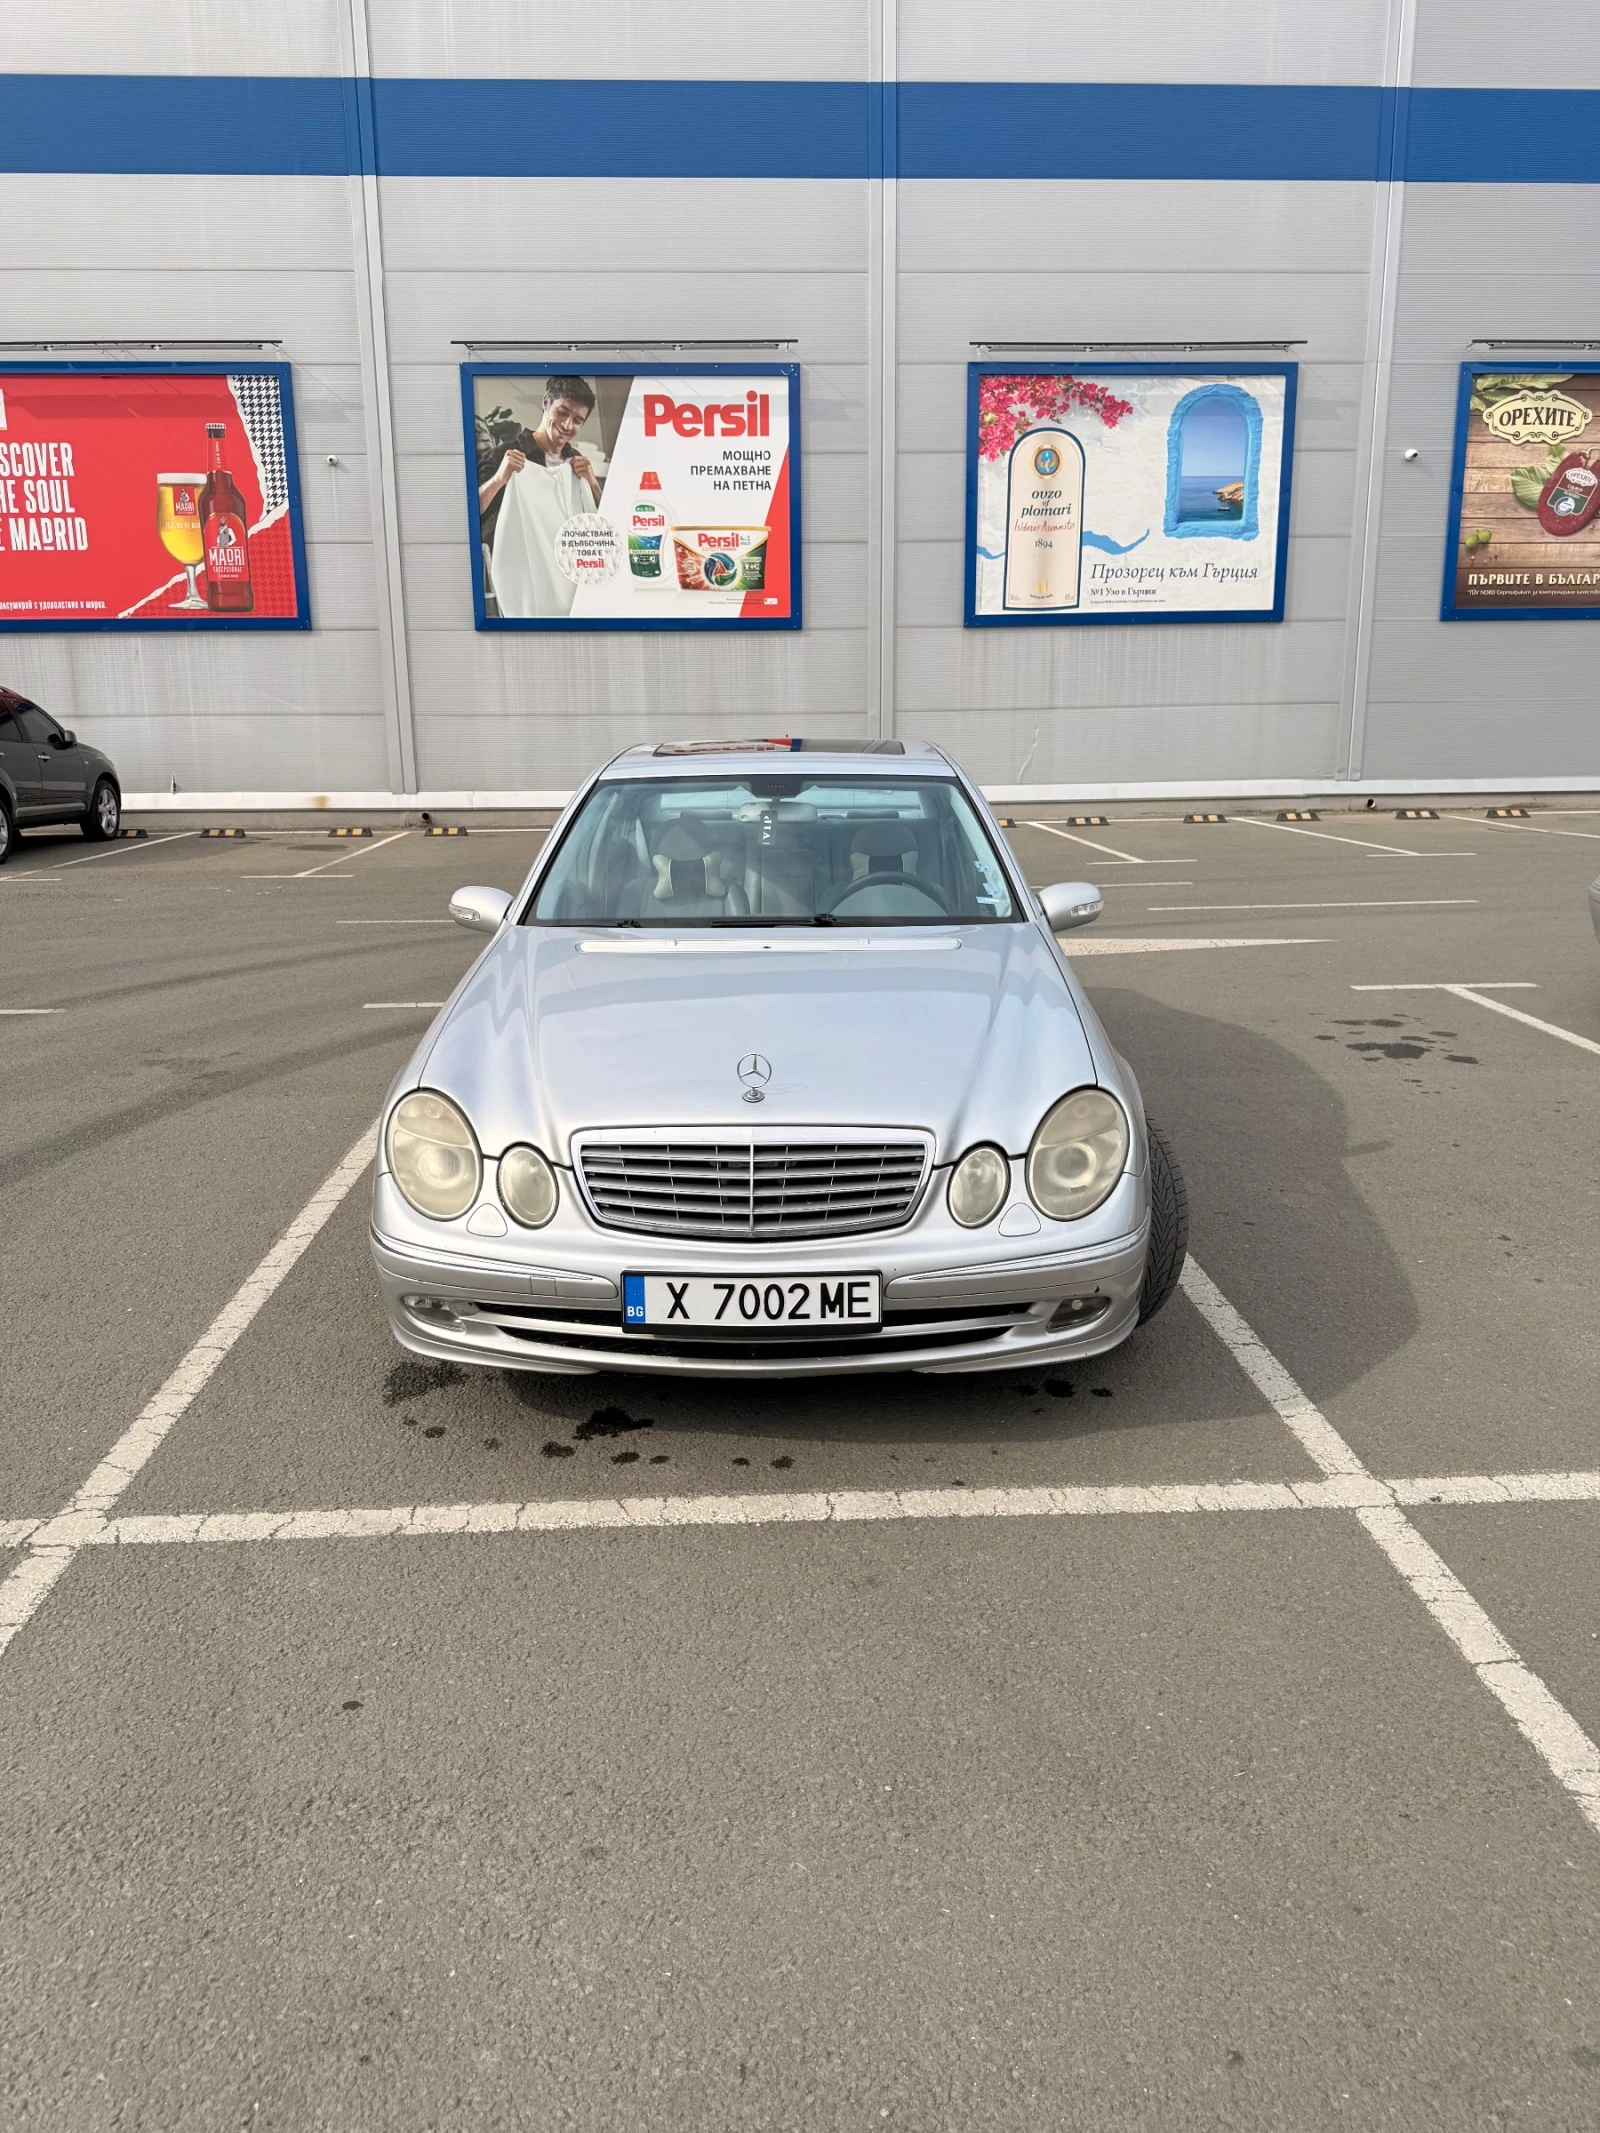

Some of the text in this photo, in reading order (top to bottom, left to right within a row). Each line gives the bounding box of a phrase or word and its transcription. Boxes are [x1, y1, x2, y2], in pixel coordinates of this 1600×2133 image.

[643, 390, 770, 438] Persil
[1499, 406, 1577, 427] ОРЕХИТЕ
[722, 450, 771, 462] МОЩНО
[690, 465, 771, 476] ПРЕМАХВАНЕ
[713, 480, 772, 491] НА ПЕТНА
[23, 479, 76, 514] SOUL
[1031, 490, 1062, 499] ouzo
[1021, 503, 1072, 518] plomari
[632, 514, 665, 527] Persil
[8, 517, 88, 551] MADRID
[564, 530, 614, 538] ПОЧИСТВАНЕ
[697, 532, 740, 548] Persil
[1035, 539, 1053, 549] 1894
[576, 558, 605, 569] Persil
[1090, 563, 1258, 583] Прозорец към Гърция
[1535, 573, 1544, 585] В
[666, 1281, 871, 1320] X 7002 ME
[627, 1306, 644, 1317] BG
